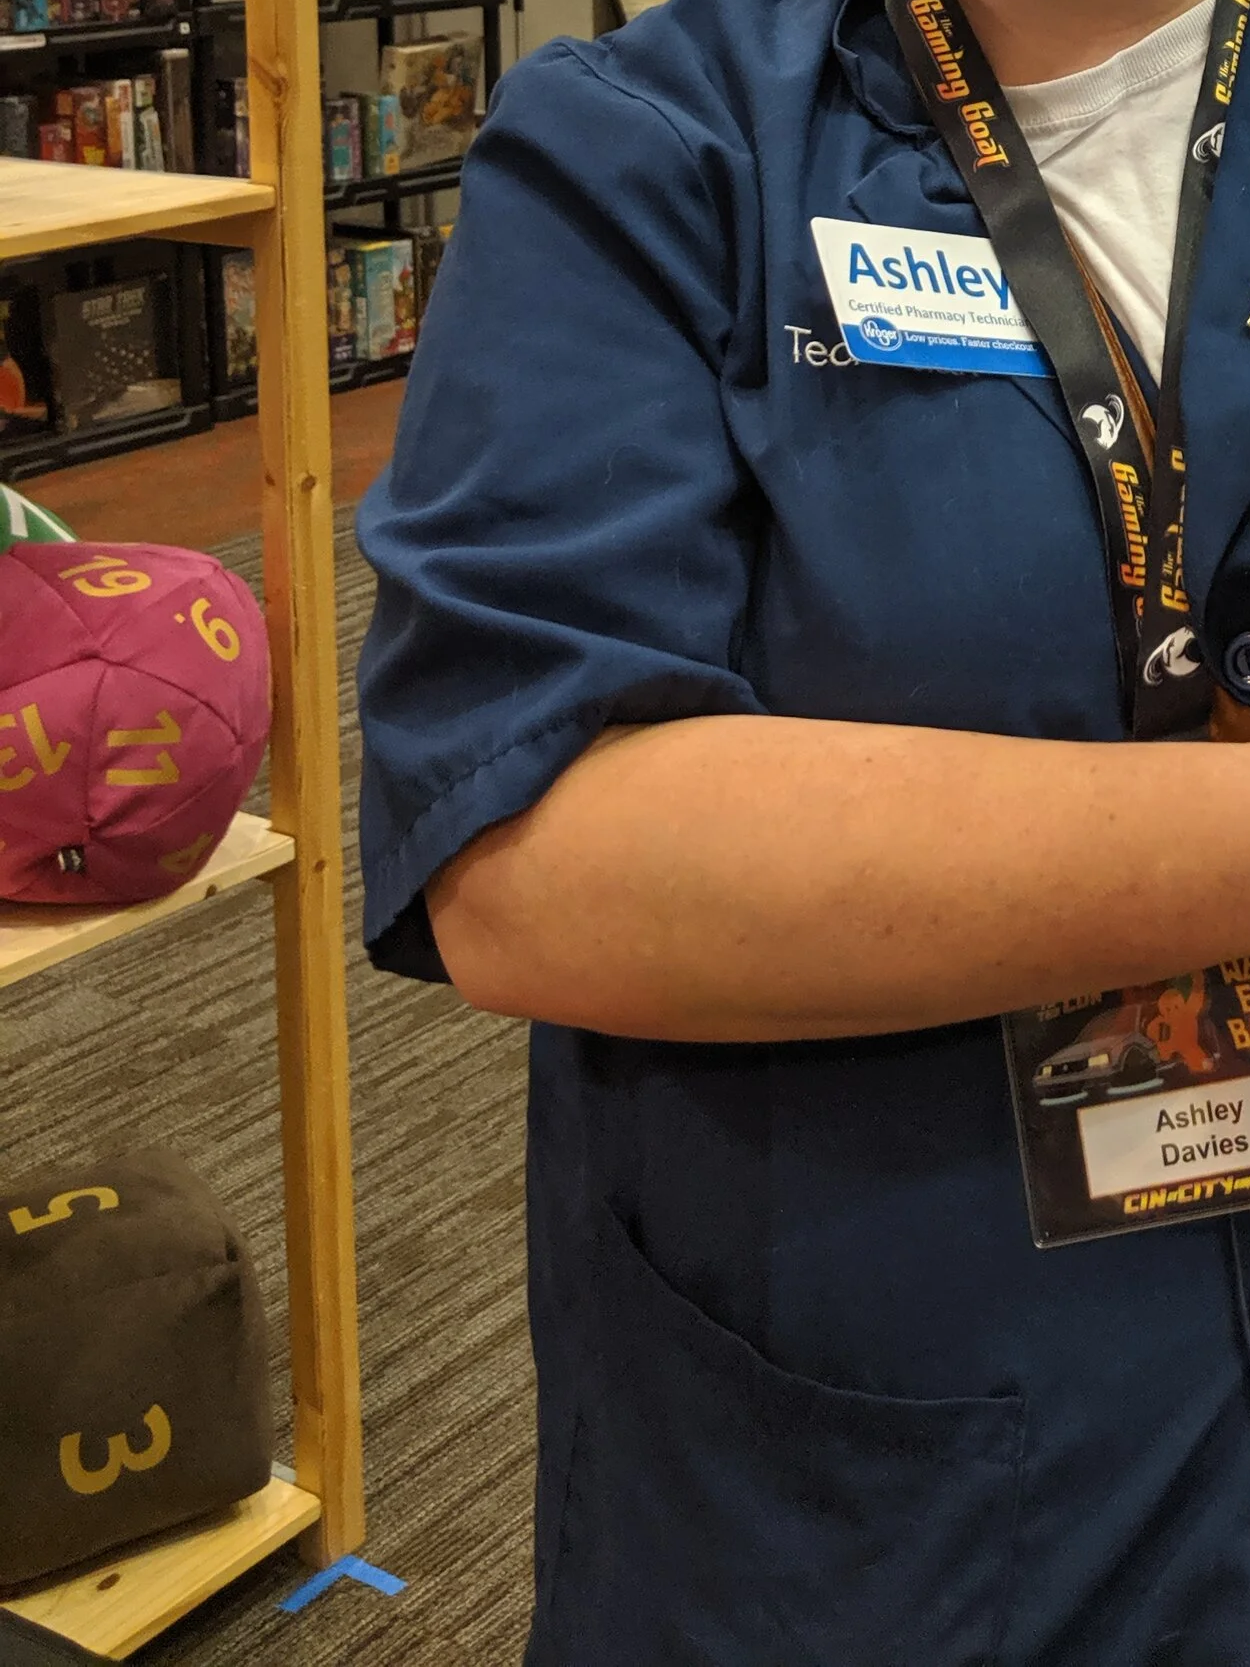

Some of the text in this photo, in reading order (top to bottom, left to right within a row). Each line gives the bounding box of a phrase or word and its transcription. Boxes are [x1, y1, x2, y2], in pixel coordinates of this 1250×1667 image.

[849, 242, 1010, 311] Ashley
[848, 298, 902, 317] Certified
[905, 306, 966, 325] Pharmacy
[863, 319, 898, 346] Kroger
[904, 332, 927, 343] Low
[1110, 460, 1149, 588] Gaming
[58, 555, 152, 597] 19
[106, 710, 181, 786] 11
[1155, 1100, 1244, 1133] Ashley
[1161, 1134, 1249, 1167] Davies
[8, 1185, 120, 1234] 5
[59, 1404, 172, 1494] 3
